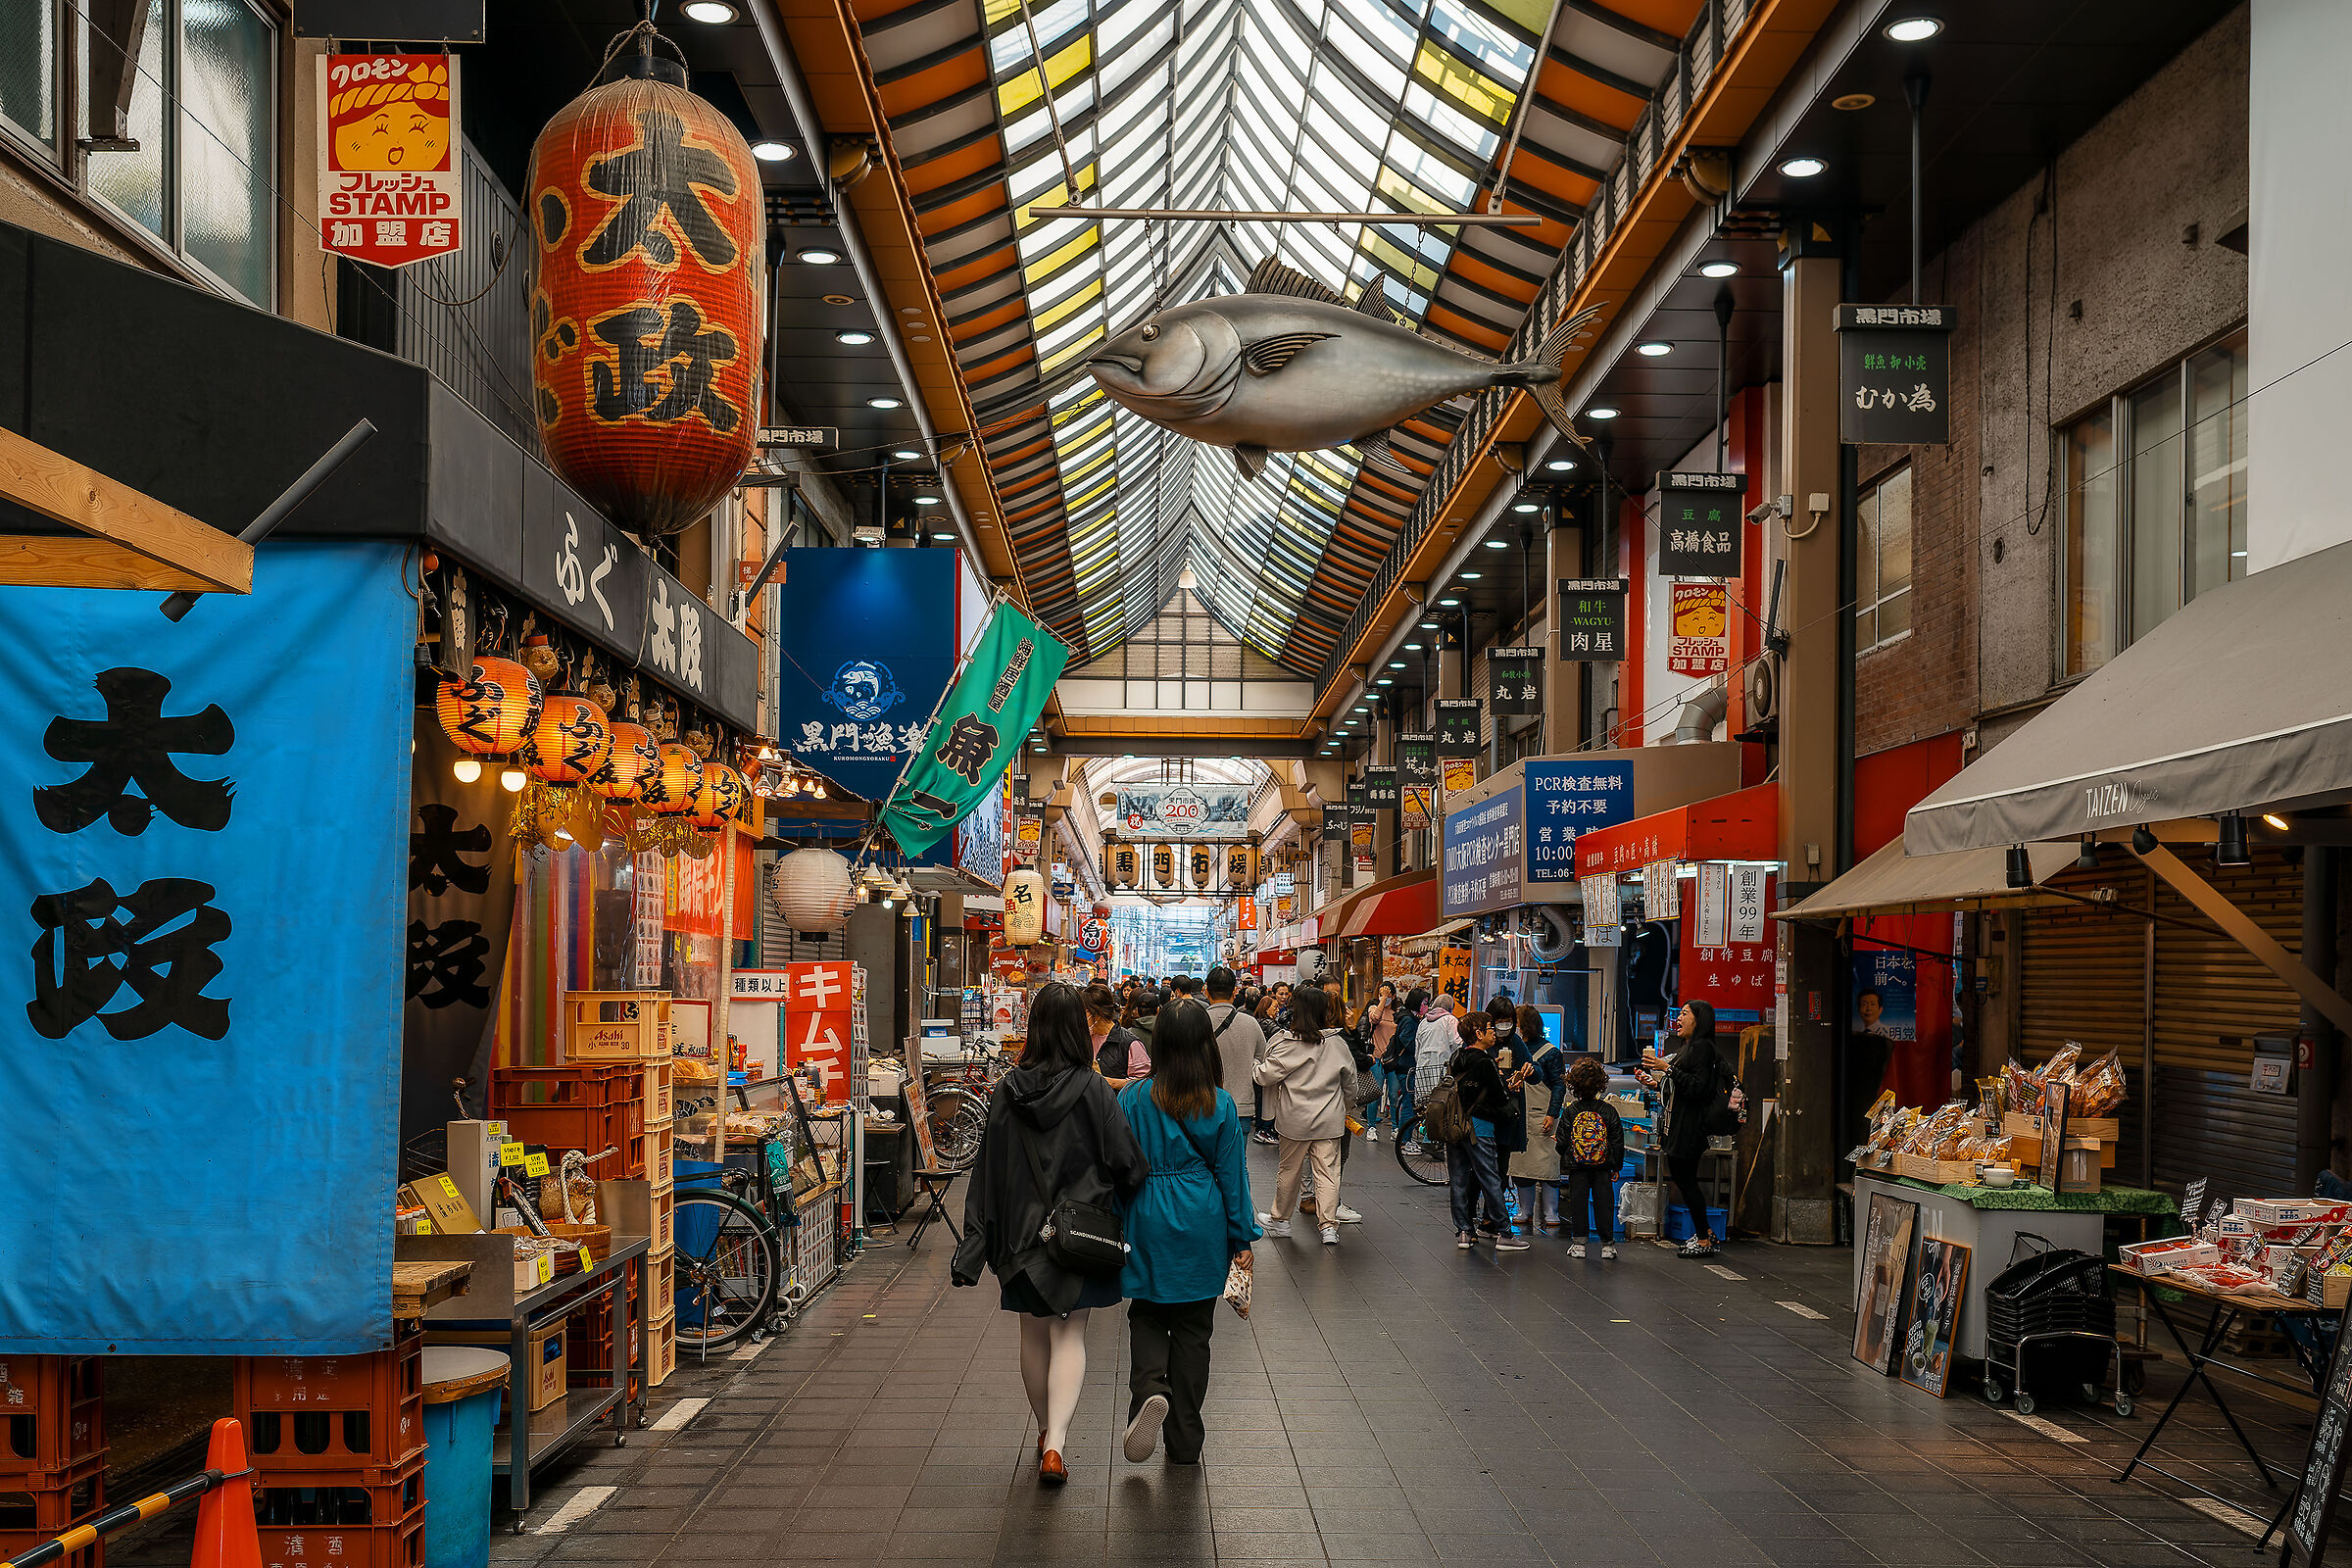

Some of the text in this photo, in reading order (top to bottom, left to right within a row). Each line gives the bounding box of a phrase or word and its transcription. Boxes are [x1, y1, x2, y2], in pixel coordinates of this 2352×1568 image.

[330, 58, 410, 88] クロモン
[339, 172, 436, 192] フレッシュ
[329, 193, 451, 216] STAMP
[330, 220, 451, 247] 加盟店
[580, 110, 740, 433] 太政
[1856, 308, 1941, 325] 黒門市場
[1864, 353, 1927, 370] 鮮魚 卸 小売
[1855, 382, 1936, 413] むか為
[1671, 474, 1738, 488] 黒門市場
[1682, 509, 1722, 522] 豆腐
[1670, 529, 1733, 554] 高橋食品
[556, 511, 618, 632] ふぐ
[1567, 580, 1620, 591] 黒門市場
[1675, 587, 1709, 601] クロモン
[1578, 599, 1607, 613] 和牛
[1571, 631, 1614, 652] 肉星
[1677, 637, 1720, 647] フレッシュ
[1494, 648, 1539, 658] 黒門市場
[1673, 646, 1725, 656] STAMP
[1672, 658, 1725, 671] 加盟店
[1495, 684, 1538, 701] 丸岩
[1441, 730, 1477, 744] 丸岩
[1535, 775, 1624, 792] PCR検査無料
[1545, 800, 1607, 814] 予約不要
[2085, 781, 2129, 819] TAIZEN
[1165, 805, 1199, 817] 200
[1012, 883, 1033, 904] 名
[1739, 869, 1757, 941] 創業99年
[1699, 948, 1774, 962] 創作豆腐
[734, 976, 787, 995] 種類以上
[1707, 973, 1765, 987] 生ゆば
[594, 1029, 624, 1041] Asahi
[1875, 1027, 1916, 1042] 公明党
[620, 1041, 630, 1050] 30
